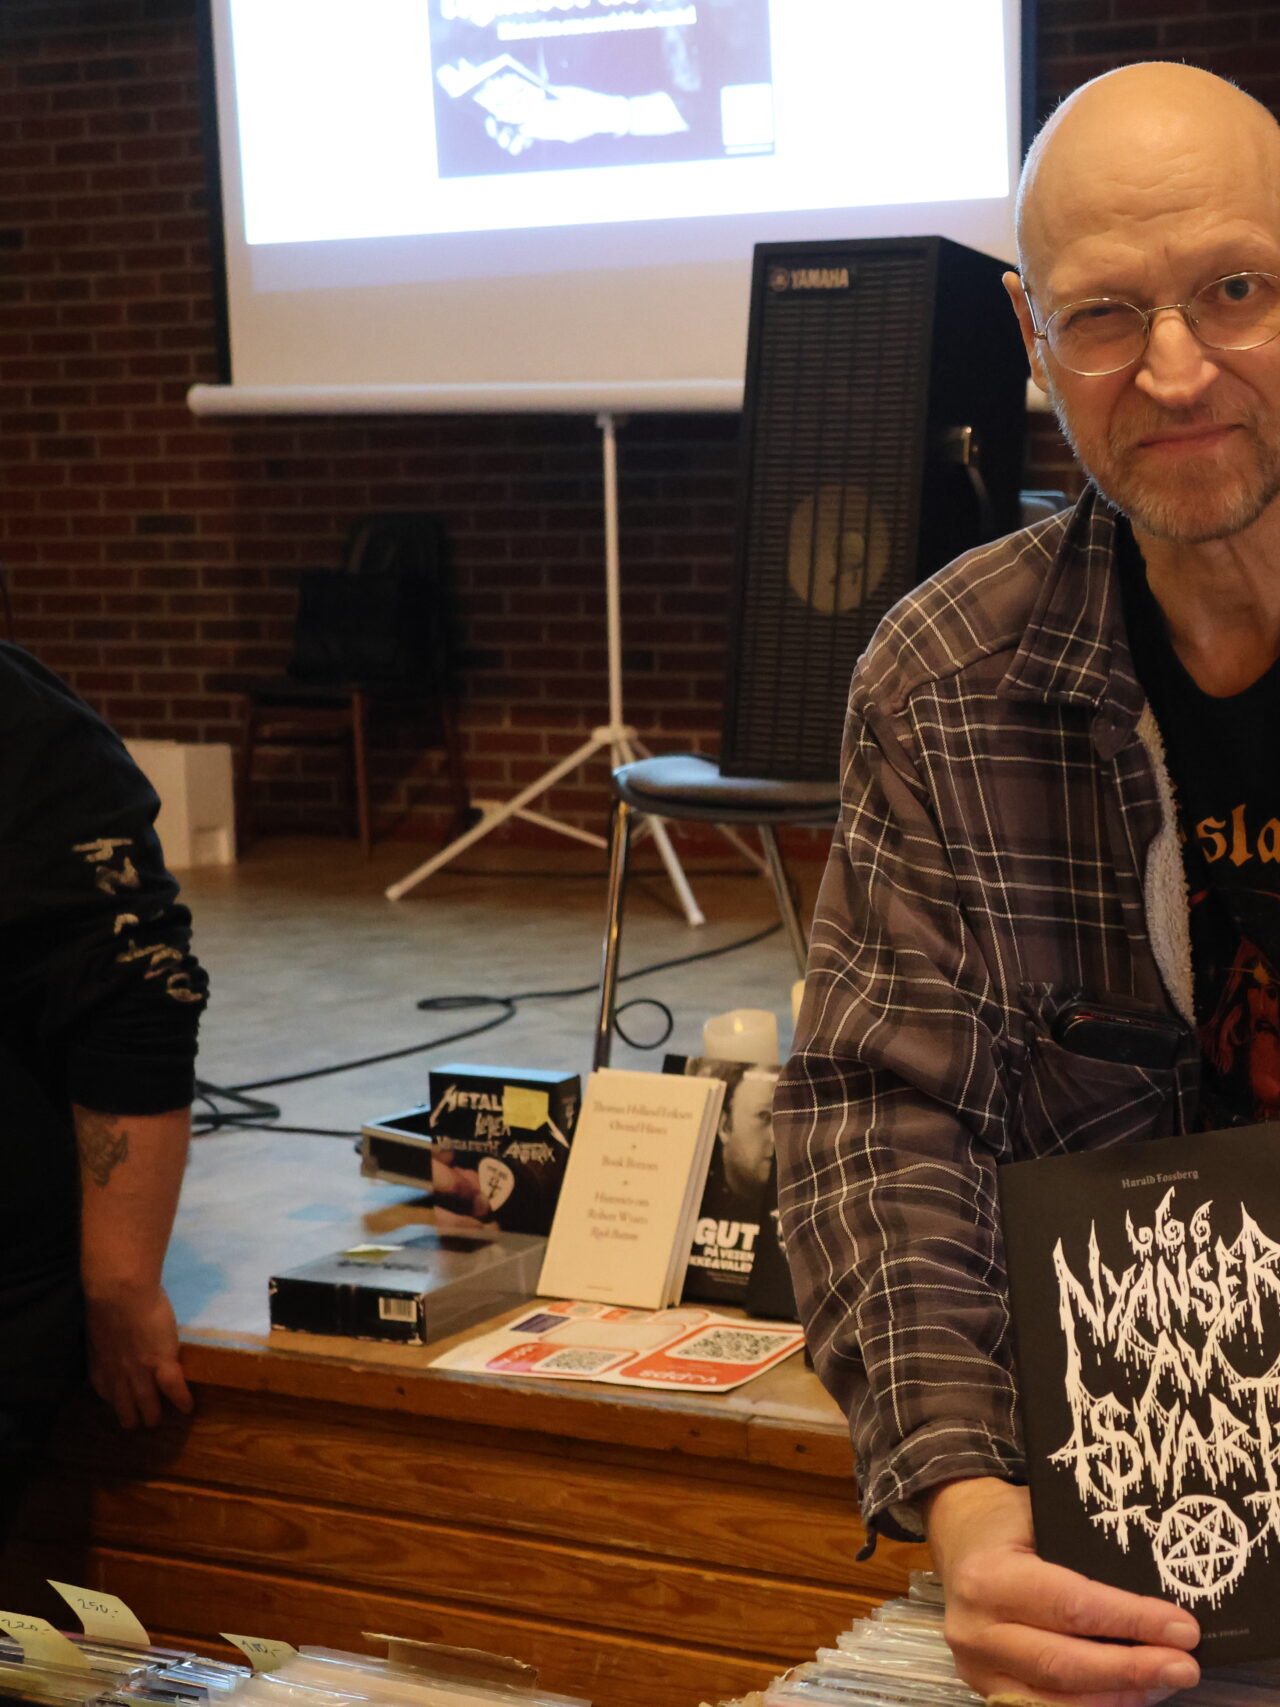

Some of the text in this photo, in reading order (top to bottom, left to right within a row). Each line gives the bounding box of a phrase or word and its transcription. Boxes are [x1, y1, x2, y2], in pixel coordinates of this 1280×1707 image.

[791, 268, 849, 290] YAMAHA
[1122, 1169, 1200, 1189] Harald Fossberg
[694, 1217, 761, 1251] GUT
[1125, 1186, 1214, 1254] 666
[1150, 1328, 1219, 1402] AV
